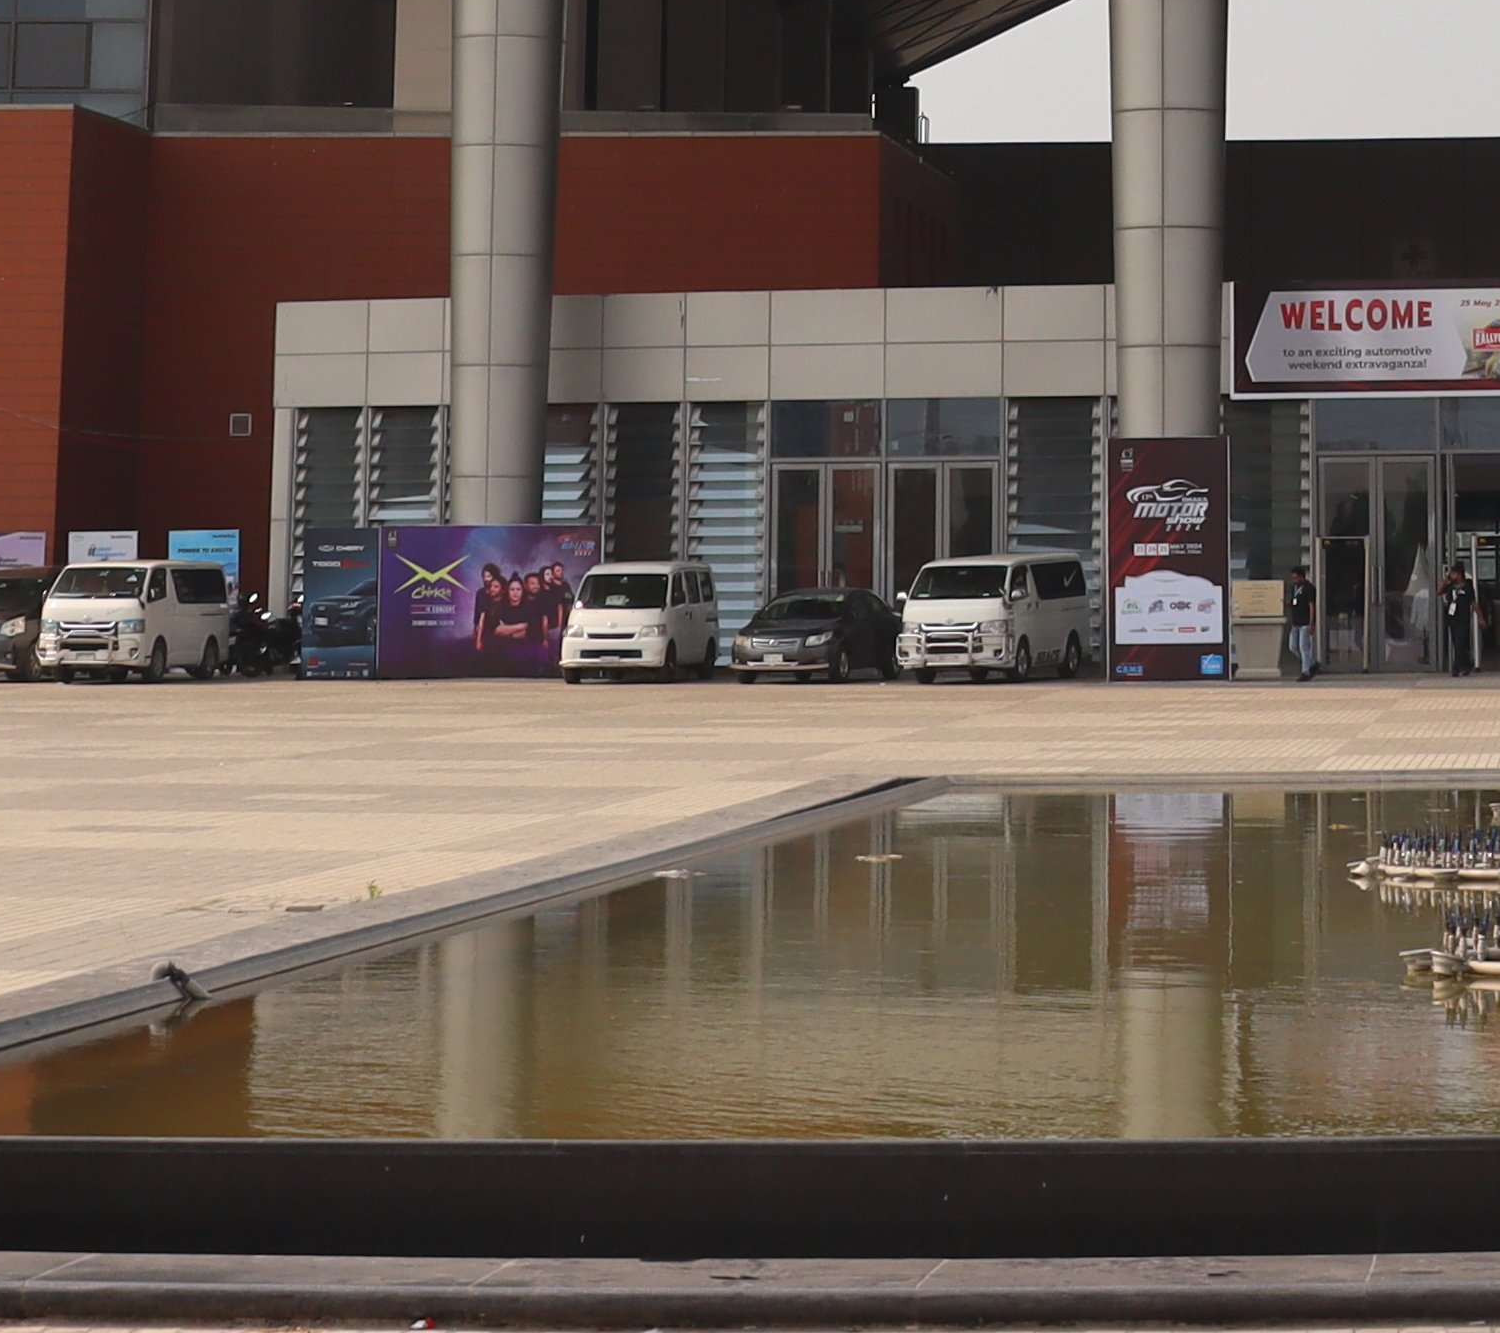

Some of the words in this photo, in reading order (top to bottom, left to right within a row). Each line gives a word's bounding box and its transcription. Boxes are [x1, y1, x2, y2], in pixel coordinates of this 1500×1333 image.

[1473, 299, 1491, 307] May
[1280, 298, 1432, 331] WELCOME
[1283, 348, 1295, 357] to
[1298, 349, 1313, 357] an
[1316, 346, 1362, 358] exciting
[1365, 345, 1432, 357] automotive
[1289, 359, 1342, 370] weekend
[1345, 359, 1427, 371] extravaganza!
[1133, 502, 1209, 518] MOTOR
[1166, 514, 1206, 524] show
